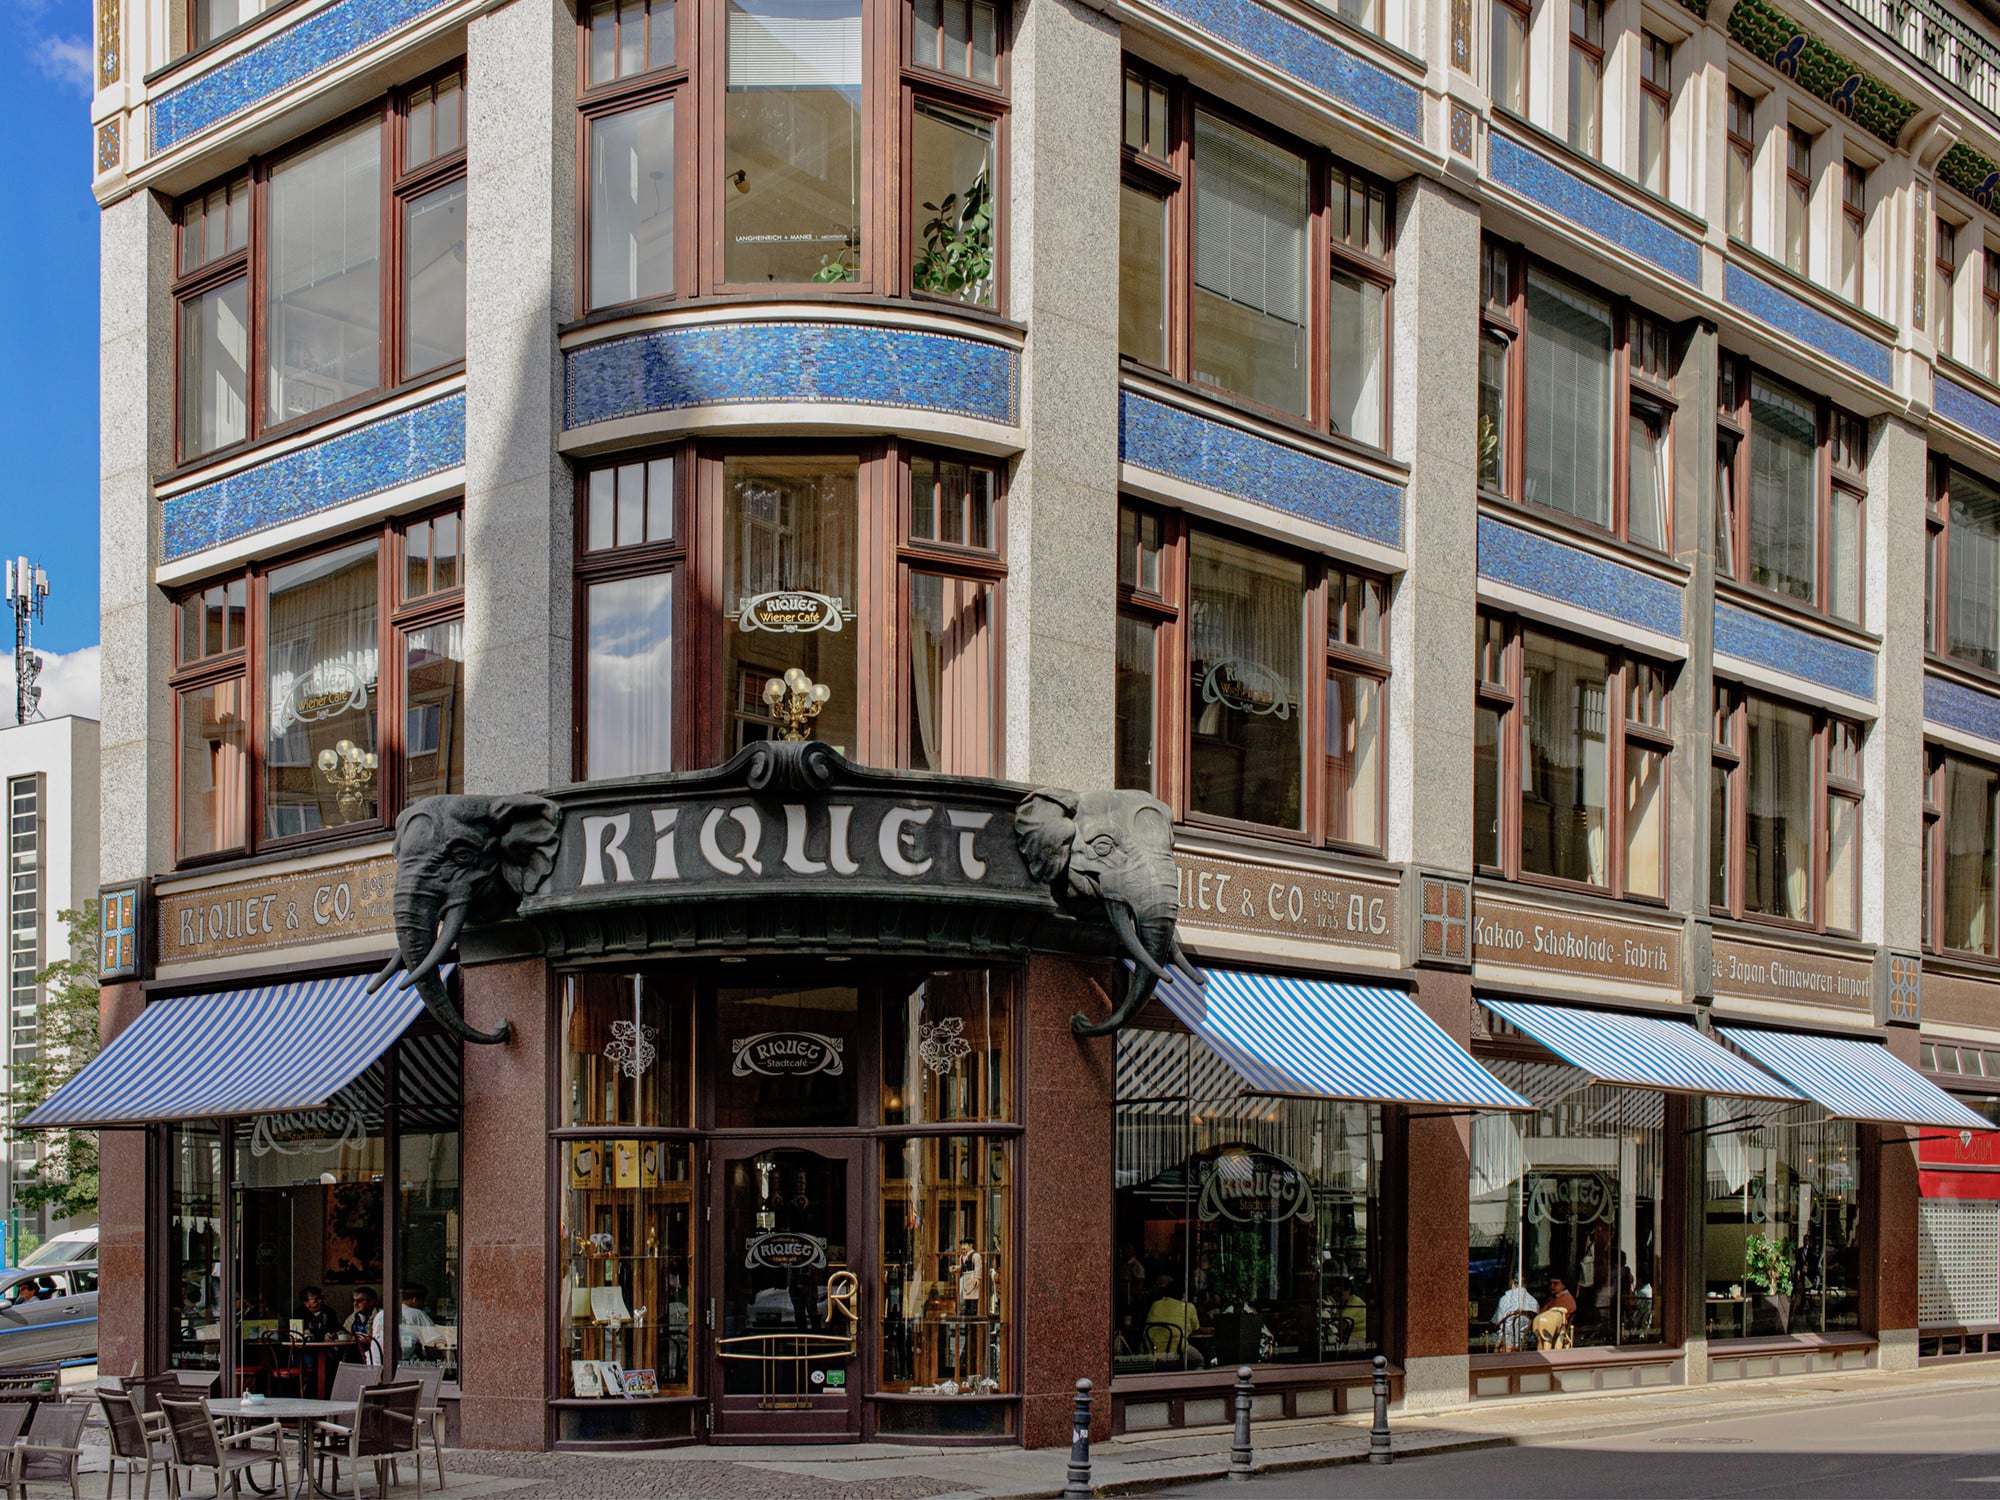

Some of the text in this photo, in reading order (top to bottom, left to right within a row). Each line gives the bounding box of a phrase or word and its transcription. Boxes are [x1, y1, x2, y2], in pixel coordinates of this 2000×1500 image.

[736, 234, 782, 242] LANGHEINRICH
[766, 598, 818, 612] RIQUET
[759, 612, 820, 623] Wiener Café
[297, 696, 327, 712] Wiener
[1177, 866, 1308, 924] UET & CO.
[285, 901, 300, 930] &
[312, 882, 356, 926] CO.
[756, 1039, 822, 1060] RIQUET
[767, 1058, 808, 1067] Stadtcafé
[760, 1243, 813, 1257] RIQUET
